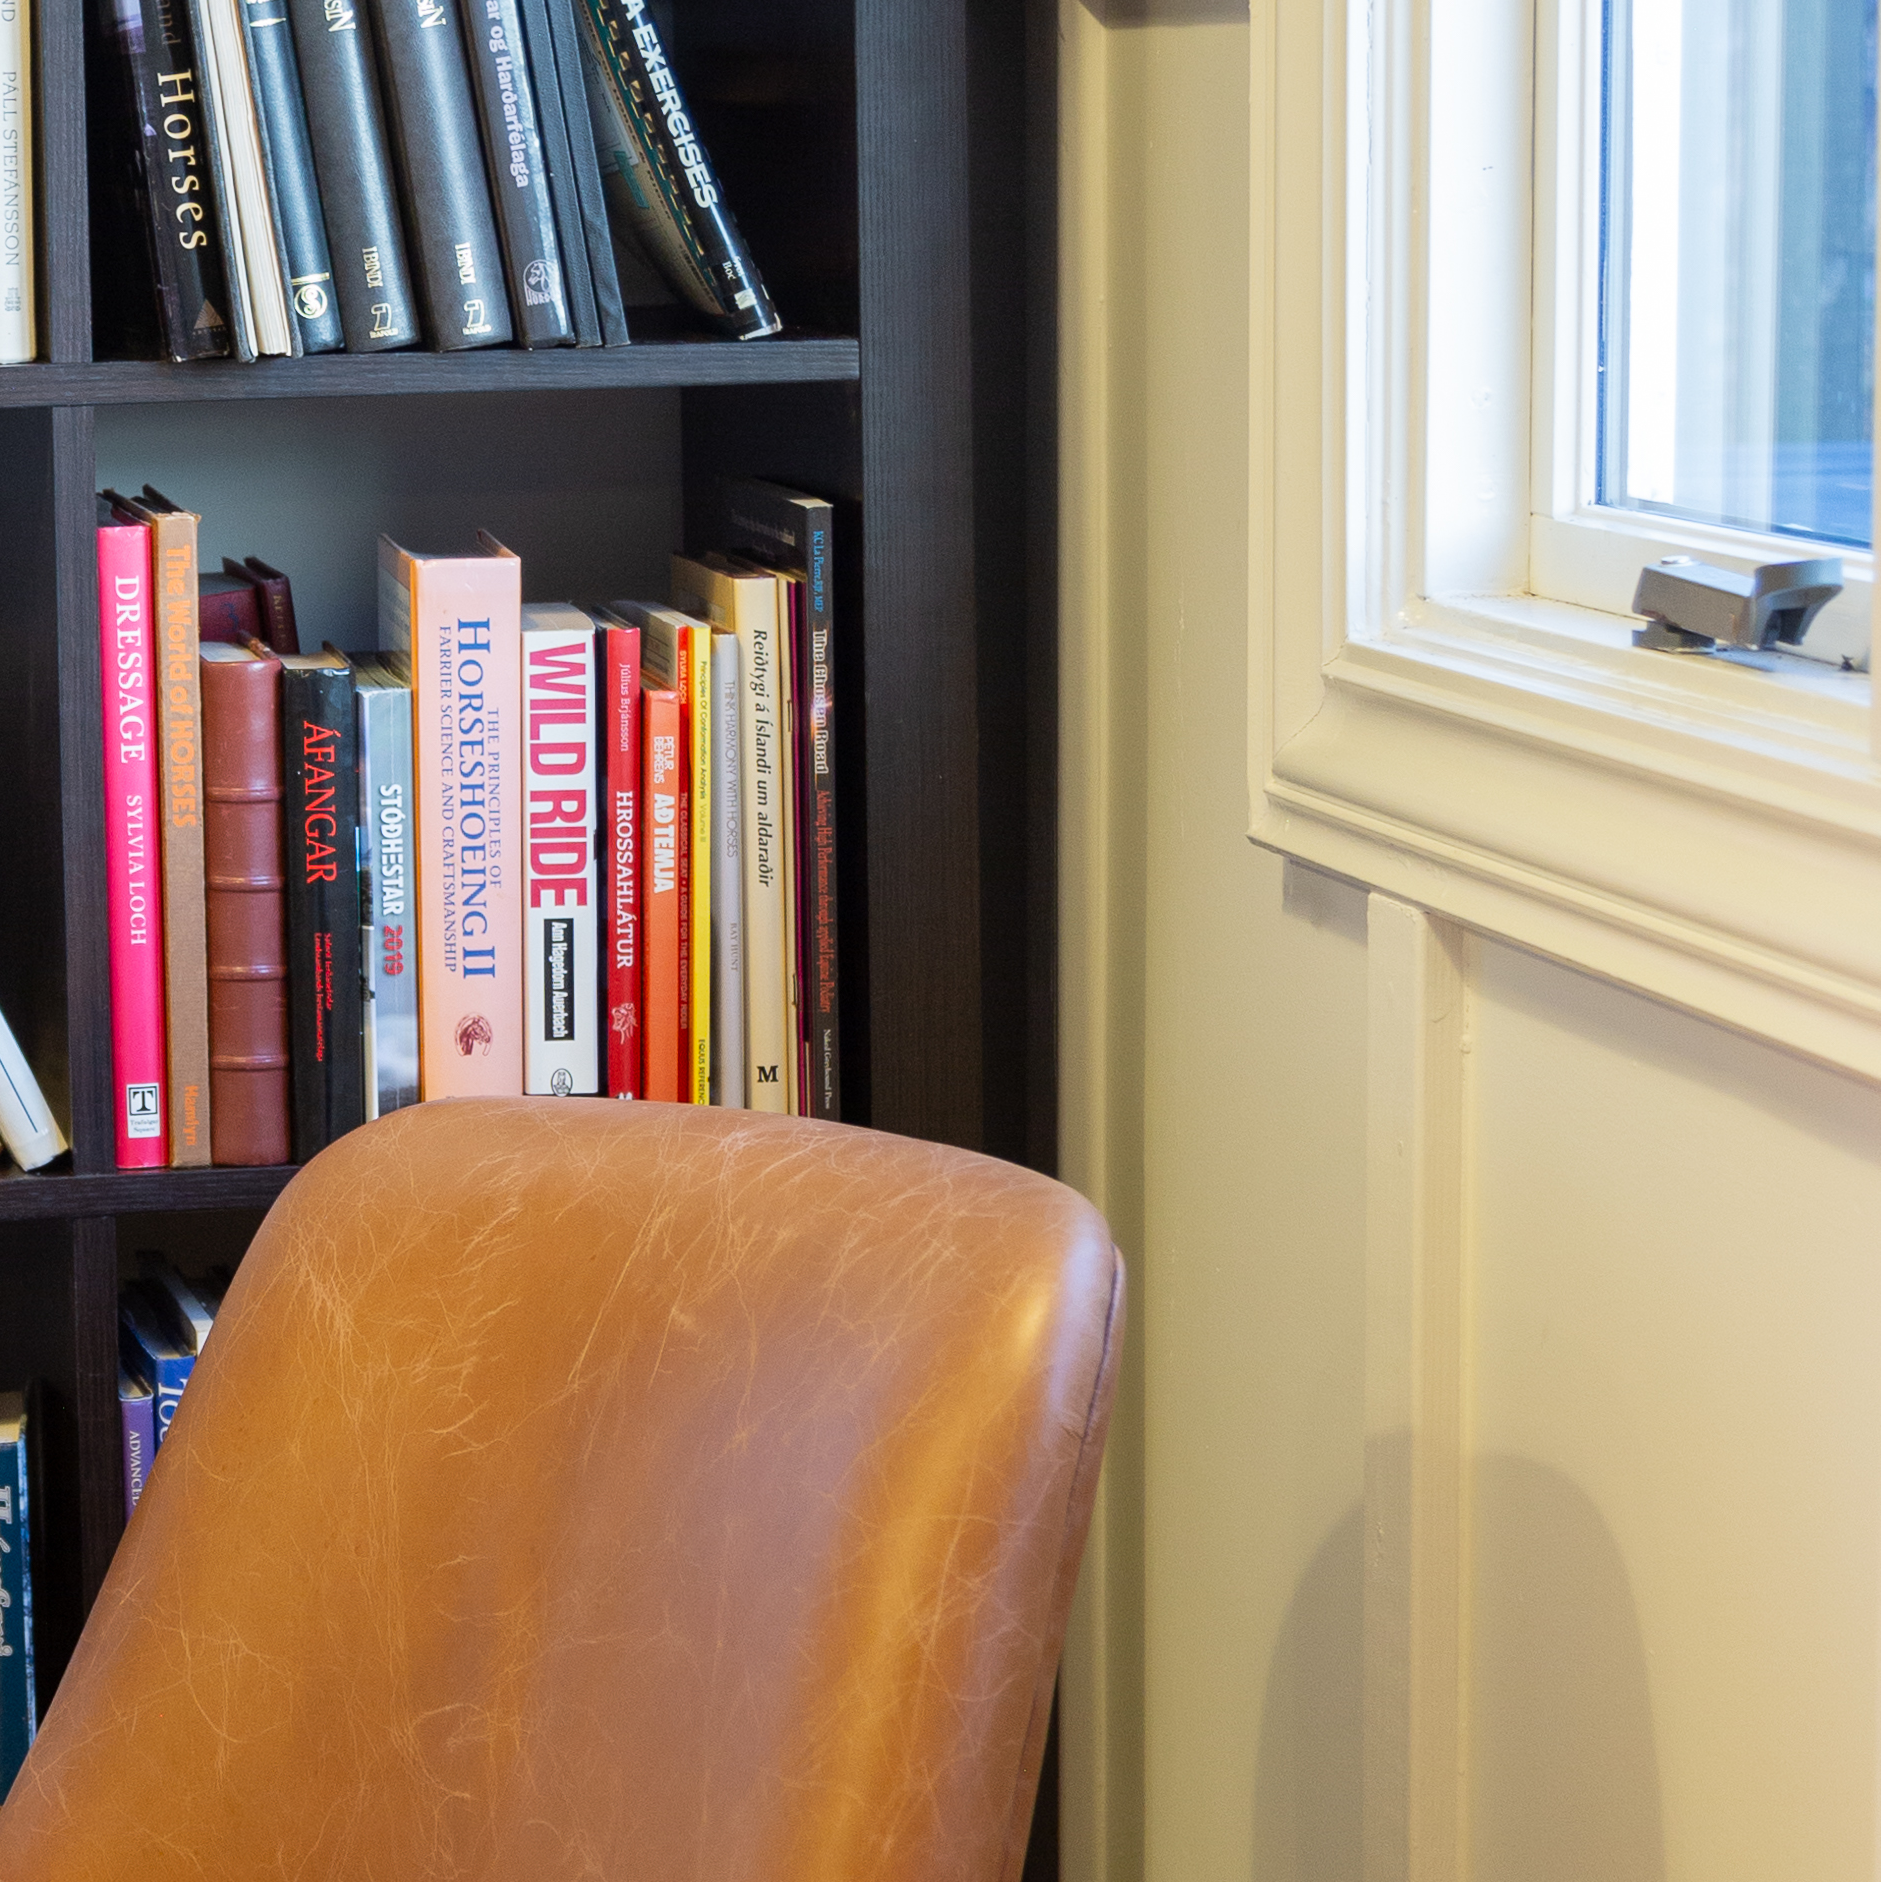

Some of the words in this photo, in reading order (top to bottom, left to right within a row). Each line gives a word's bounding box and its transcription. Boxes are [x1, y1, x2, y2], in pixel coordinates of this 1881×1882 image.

[3, 72, 19, 121] PÁLL
[632, 23, 719, 208] EXERCISES
[157, 69, 207, 250] Horses
[3, 129, 20, 266] STEFÁNSSON
[166, 545, 191, 595] The
[114, 576, 145, 764] DRESSAGE
[167, 600, 192, 681] World
[440, 626, 452, 699] FARRIER
[750, 629, 769, 696] Reiðtygi
[170, 686, 193, 713] of
[529, 642, 587, 776] WILD
[699, 661, 708, 698] Principles
[756, 703, 769, 712] á
[441, 705, 453, 777] SCIENCE
[487, 708, 500, 744] THE
[700, 712, 708, 765] Conformation
[755, 719, 773, 774] Íslandi
[170, 720, 197, 827] HORSES
[303, 721, 340, 884] ÁFANGAR
[442, 783, 454, 819] AND
[488, 752, 502, 858] PRINCIPLES
[699, 768, 707, 799] Analysis
[757, 780, 769, 805] um
[125, 794, 146, 875] SYLVIA
[529, 789, 587, 908] RIDE
[757, 812, 773, 887] aldaraðir
[441, 826, 456, 972] CRAFTSMANSHIP
[490, 866, 502, 888] OF
[129, 882, 146, 945] LOCH
[552, 922, 567, 941] Ann
[549, 943, 567, 989] Hagedorn
[553, 991, 569, 1037] Auerbach
[183, 1085, 199, 1145] Hamlyn
